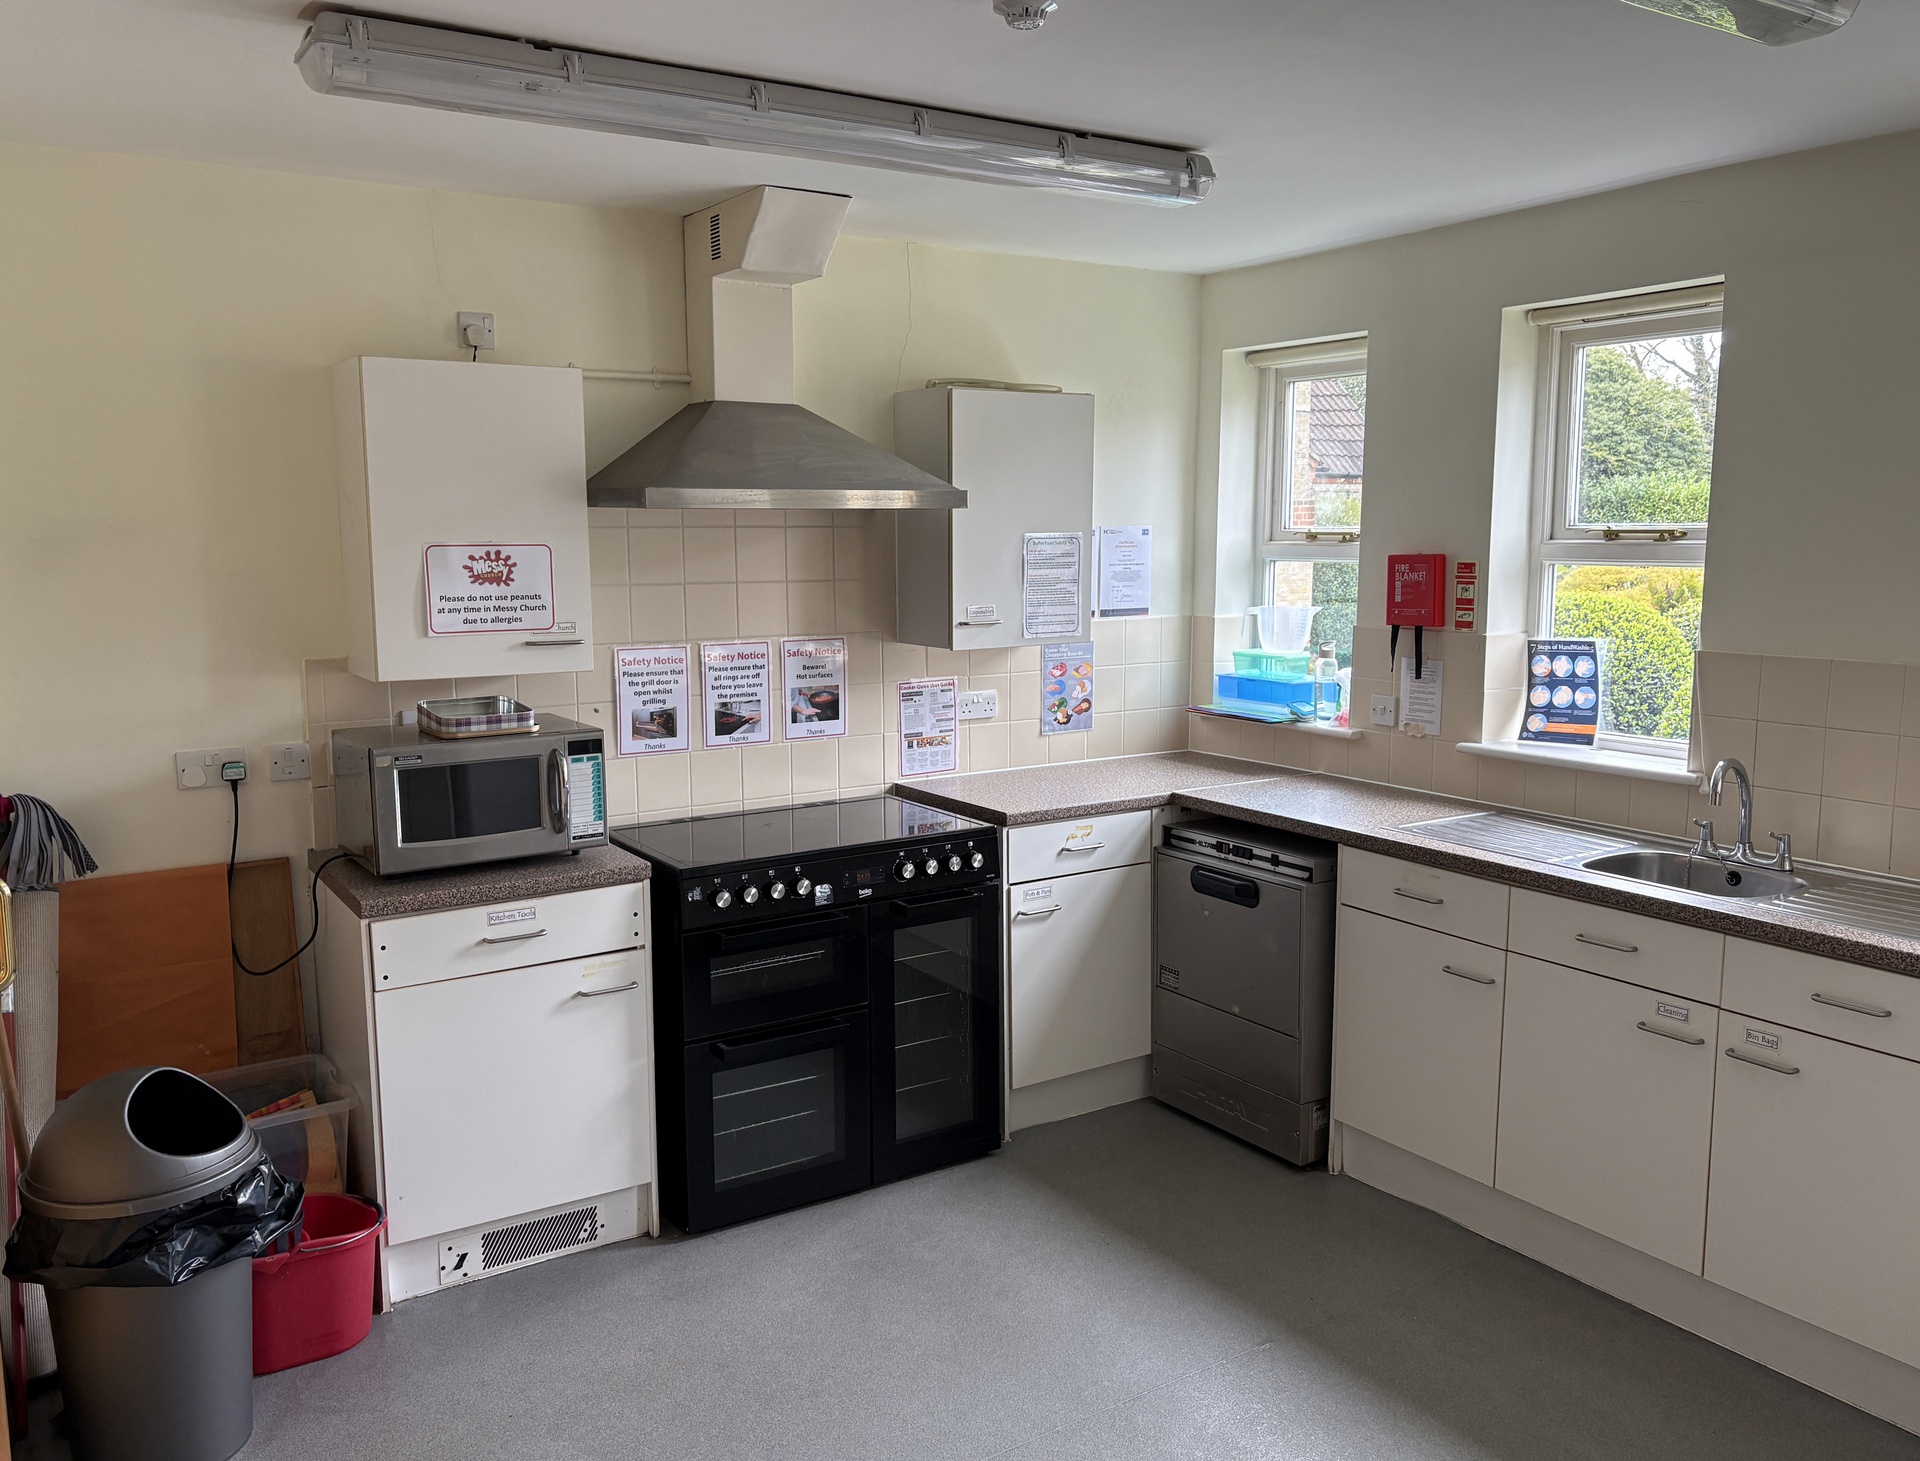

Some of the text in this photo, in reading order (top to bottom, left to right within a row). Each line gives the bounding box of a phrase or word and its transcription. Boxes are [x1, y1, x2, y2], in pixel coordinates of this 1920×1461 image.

[471, 558, 509, 580] Messy
[1395, 564, 1410, 572] FIRE
[1395, 572, 1427, 581] BLANKET
[439, 594, 465, 603] Please
[467, 594, 478, 602] do
[510, 593, 542, 603] peanuts
[447, 607, 462, 616] any
[463, 605, 482, 613] time
[483, 605, 491, 613] in
[493, 605, 518, 614] Messy
[519, 604, 547, 612] Church
[463, 617, 478, 625] due
[490, 615, 523, 626] allergies
[786, 646, 842, 659] Safety Notice
[1530, 644, 1537, 654] 7
[1537, 643, 1551, 651] Steps
[621, 656, 684, 668] Safety Notice
[706, 651, 766, 663] Safety Notice
[708, 665, 729, 673] Please
[802, 663, 827, 671] Beware!
[622, 668, 684, 678] Please ensure that
[722, 673, 738, 681] rings
[796, 671, 834, 680] Hot surfaces
[641, 678, 655, 688] grill
[655, 678, 672, 686] door
[711, 683, 732, 691] before
[746, 681, 764, 689] leave
[633, 687, 673, 697] open whilst
[717, 690, 758, 700] the premises
[641, 697, 667, 707] grilling
[806, 728, 826, 736] Thanks
[644, 742, 666, 751] Thanks
[489, 909, 535, 922] Kitchen Tools
[1658, 1004, 1688, 1020] Cleaning
[1747, 1031, 1778, 1048] Bin Bags
